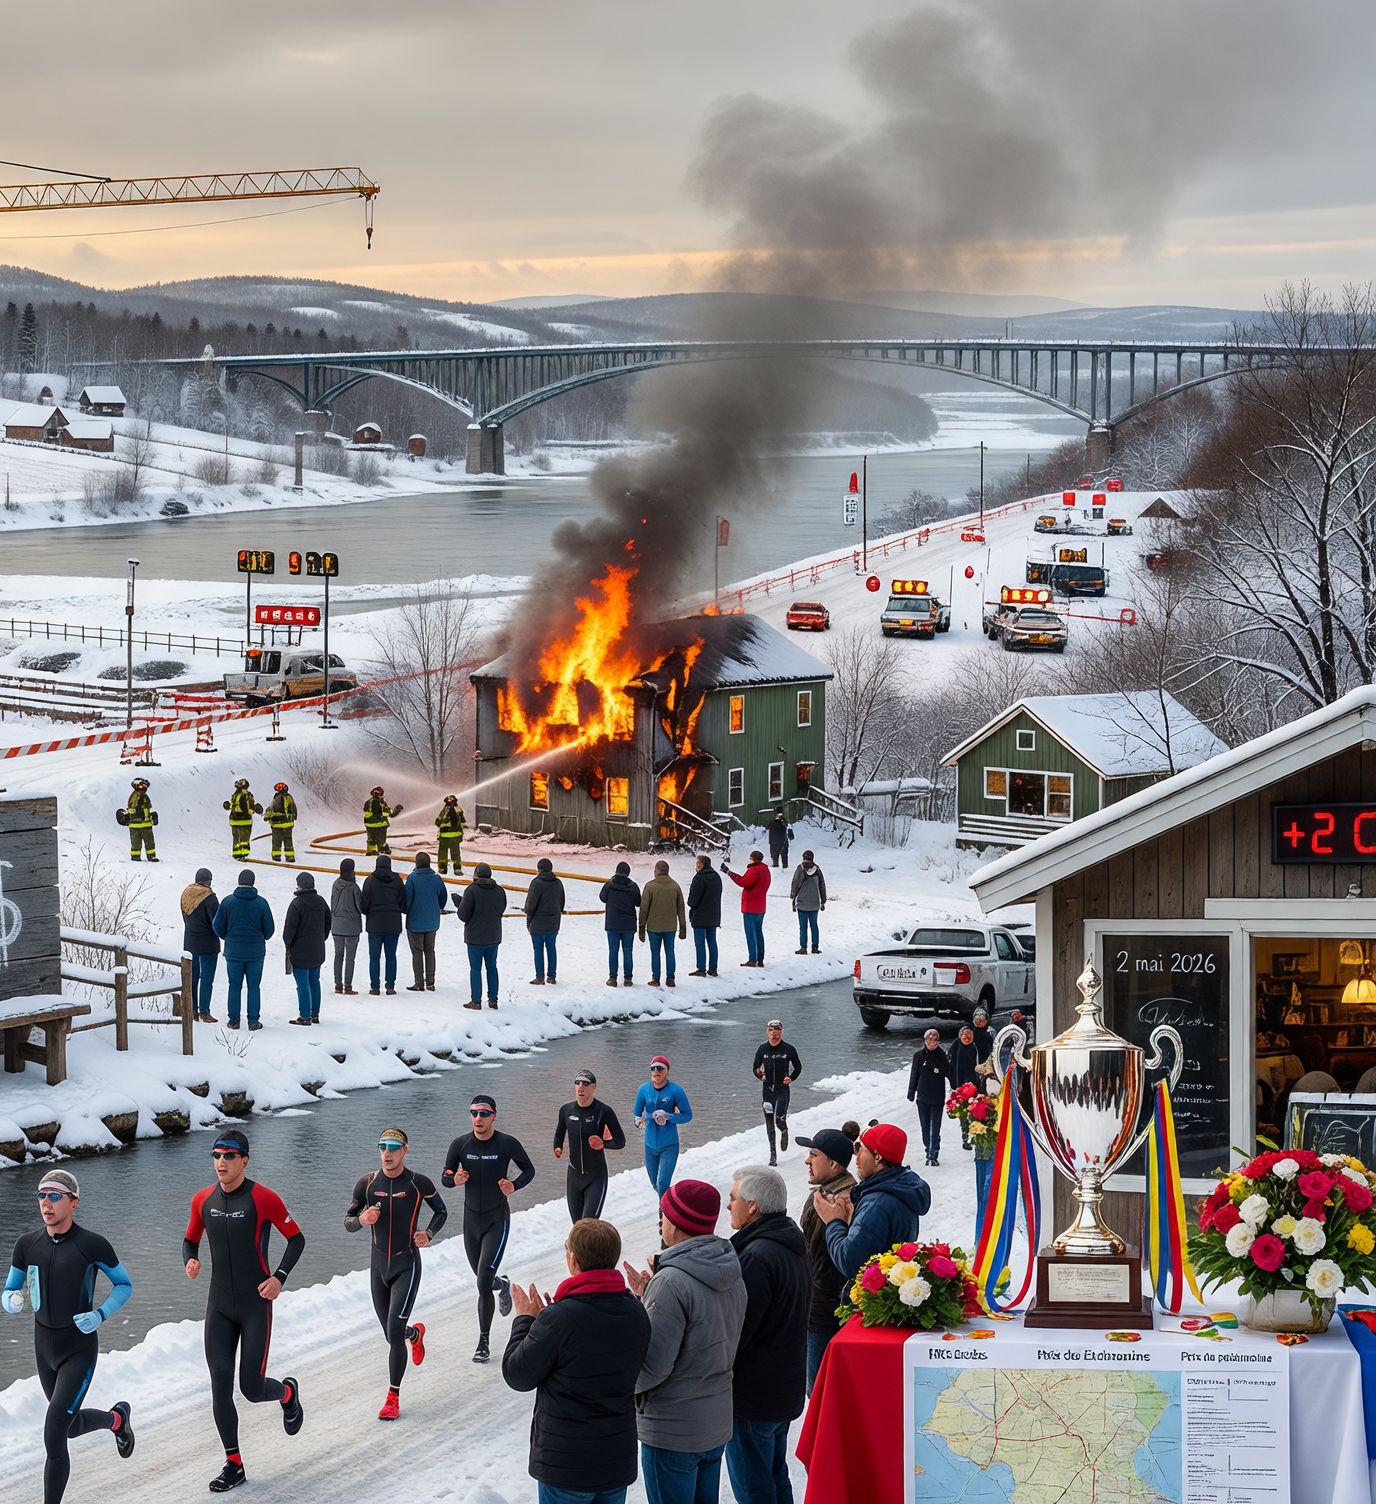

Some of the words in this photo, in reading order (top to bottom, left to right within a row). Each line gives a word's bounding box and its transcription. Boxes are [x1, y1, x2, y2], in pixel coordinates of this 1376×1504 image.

[1116, 950, 1129, 973] 2
[1135, 954, 1164, 972] mai
[1170, 952, 1216, 974] 2026
